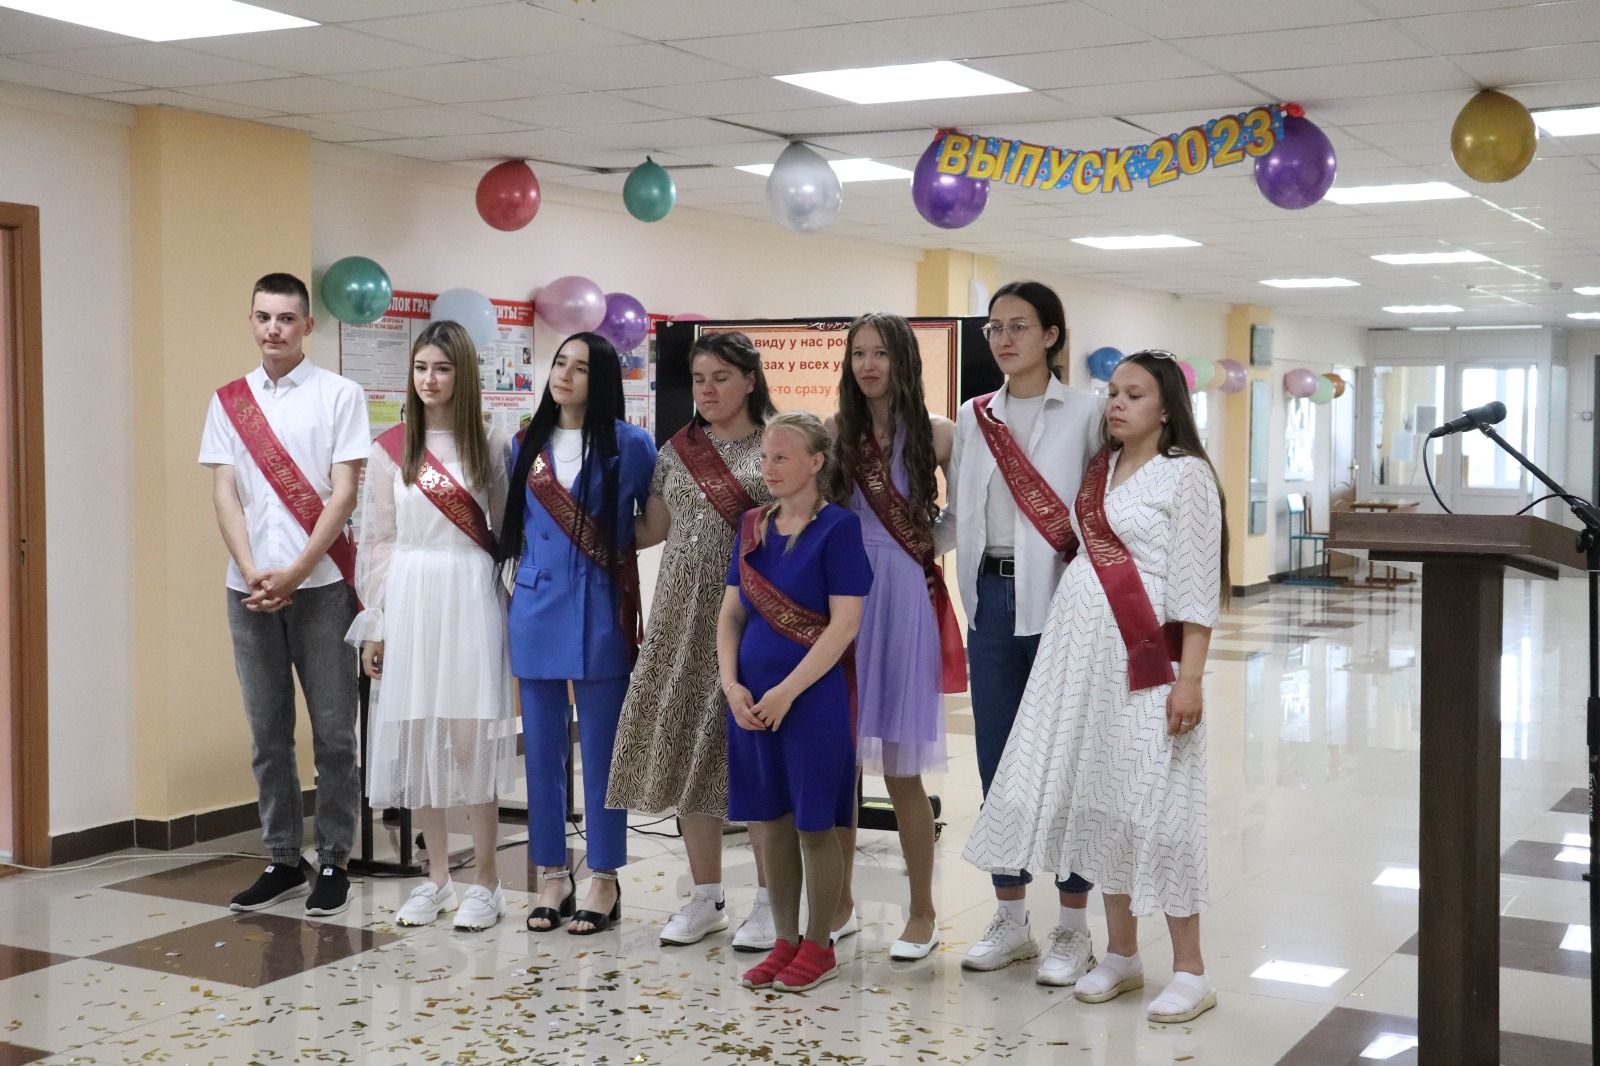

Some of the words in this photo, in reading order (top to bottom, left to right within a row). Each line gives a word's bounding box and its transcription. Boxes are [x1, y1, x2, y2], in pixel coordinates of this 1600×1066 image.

[936, 132, 1134, 194] ВЫПУСК
[1146, 106, 1276, 187] 2023
[387, 297, 410, 312] ЛОК
[495, 305, 518, 320] ИТЫ
[754, 338, 786, 350] виду
[790, 338, 797, 350] у
[801, 338, 824, 347] нас
[764, 361, 785, 370] зах
[789, 361, 796, 372] у
[800, 361, 829, 370] всех
[833, 361, 841, 372] у
[768, 385, 791, 394] к-то
[795, 385, 832, 397] сразу
[1085, 532, 1127, 568] 2023
